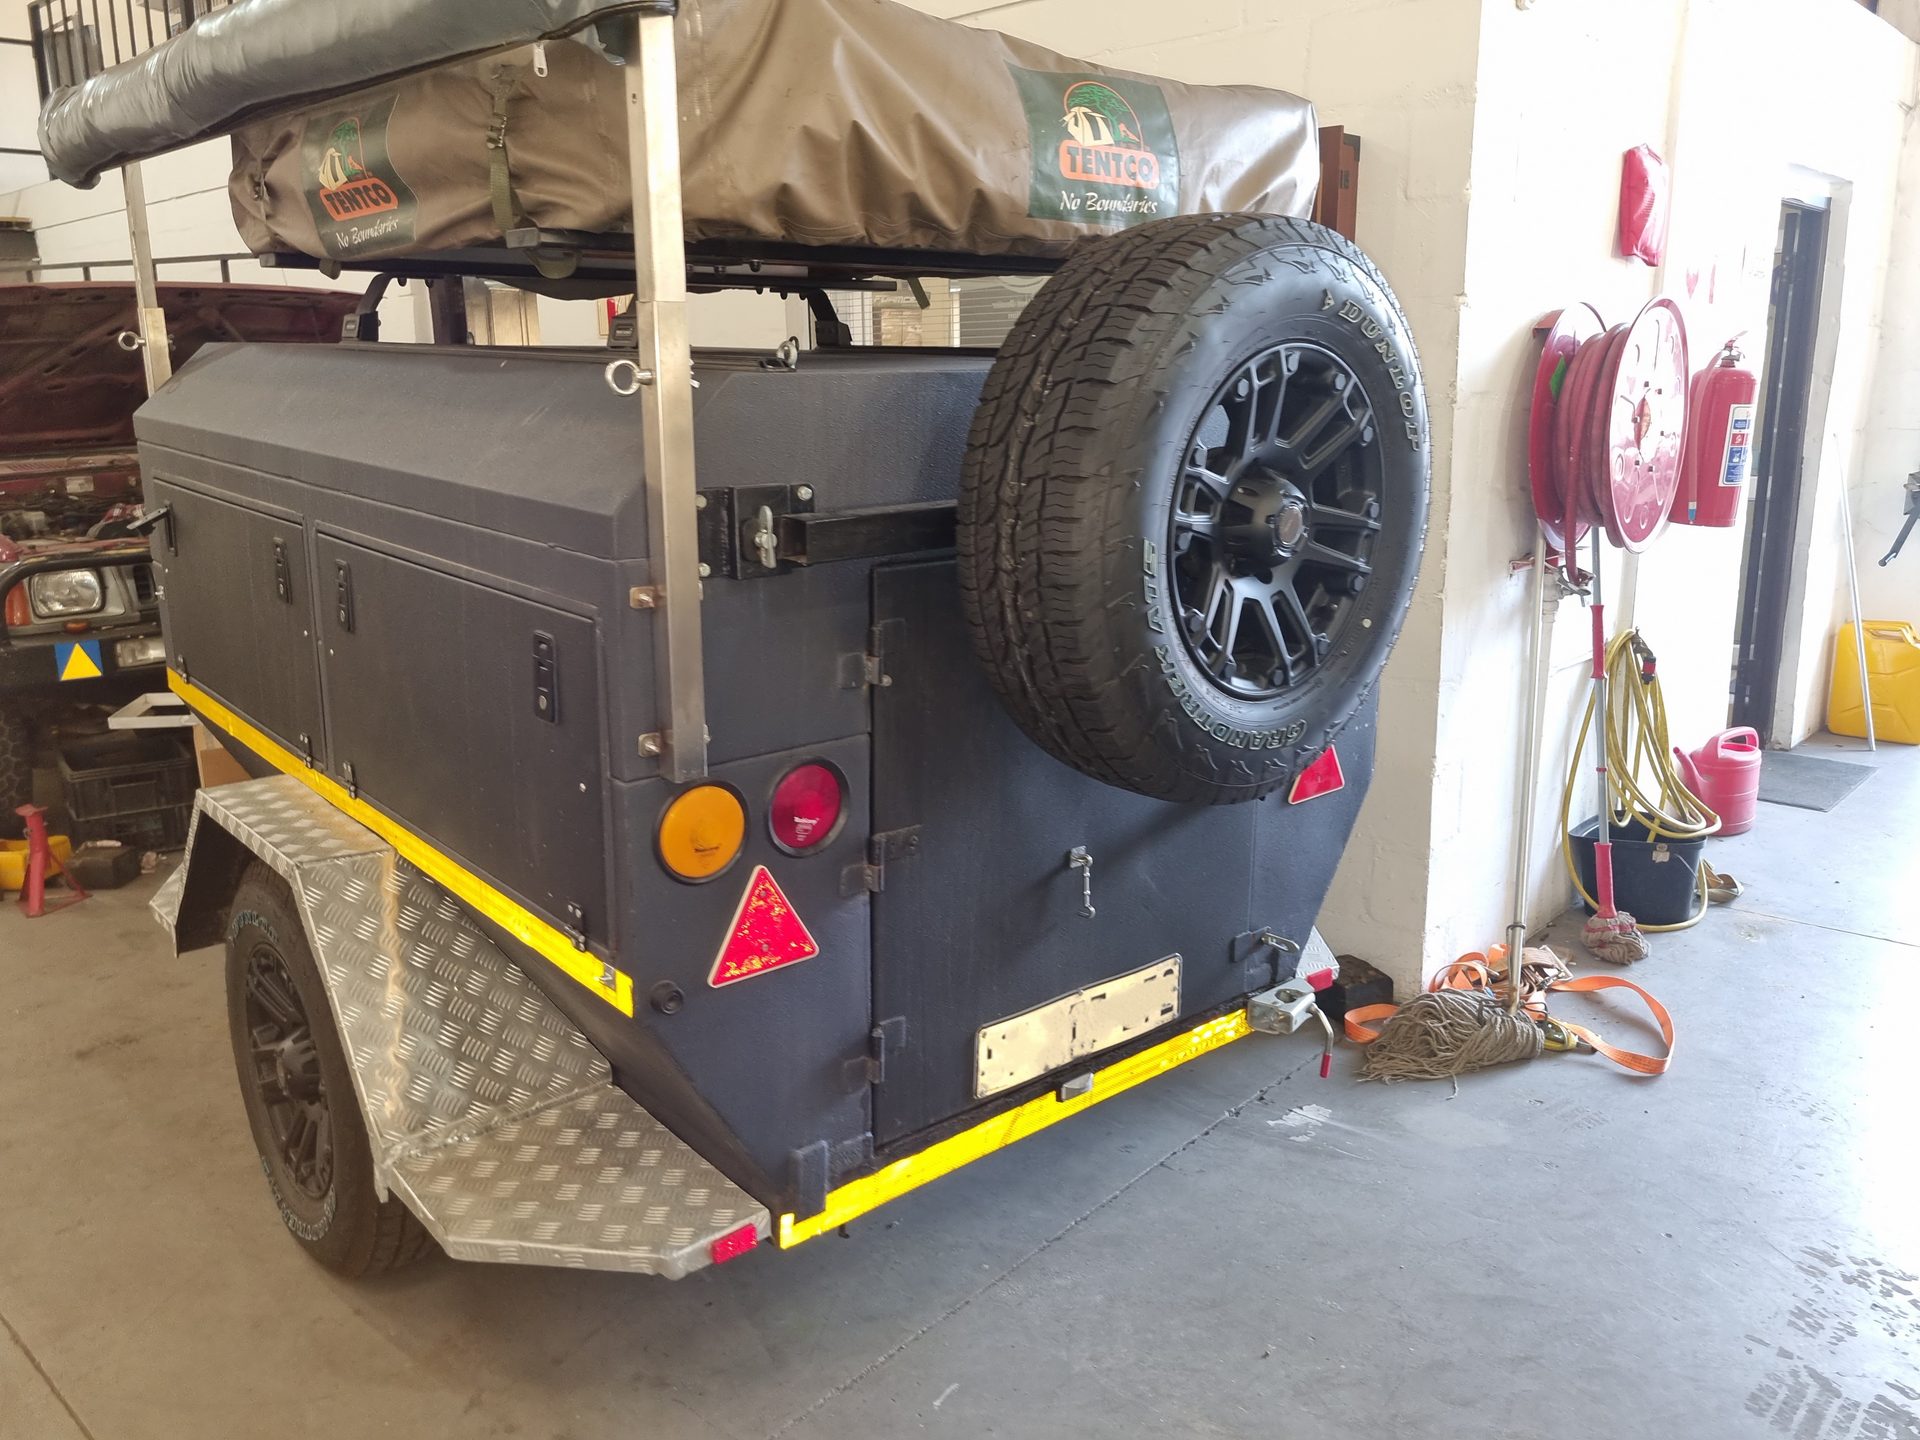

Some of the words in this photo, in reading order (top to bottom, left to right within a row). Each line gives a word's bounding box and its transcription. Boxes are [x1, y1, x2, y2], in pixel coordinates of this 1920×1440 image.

[1066, 146, 1154, 183] TENTCO
[324, 183, 392, 215] TENTCO
[1060, 190, 1081, 211] No
[1085, 192, 1158, 214] Boundaries
[335, 232, 349, 250] No
[350, 216, 399, 245] Boundaries
[1338, 299, 1421, 451] DUNLOP
[1153, 643, 1308, 750] GRANDTREK
